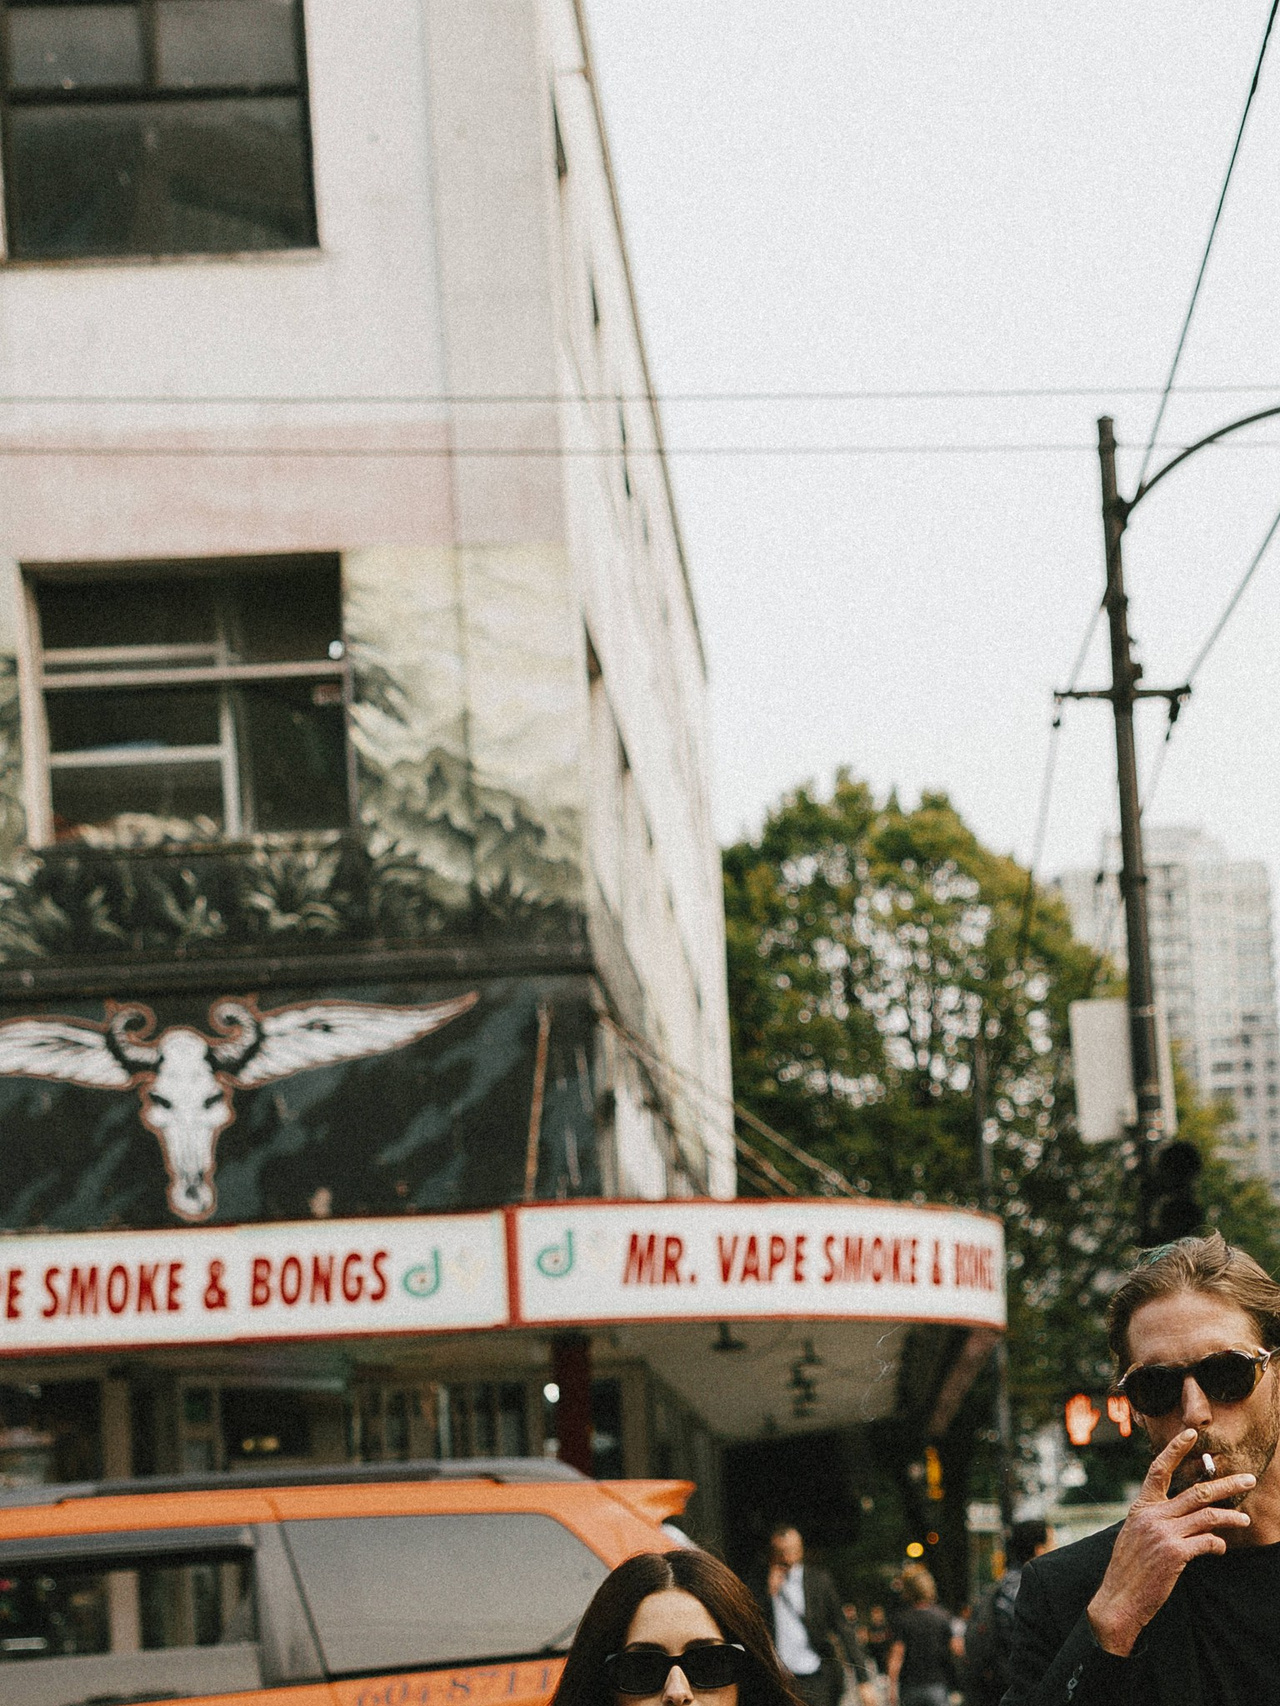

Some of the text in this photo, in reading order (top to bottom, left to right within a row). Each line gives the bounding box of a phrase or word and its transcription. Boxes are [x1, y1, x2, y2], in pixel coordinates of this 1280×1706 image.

[0, 1251, 389, 1319] E SMOKE & BONGS
[622, 1233, 697, 1284] MR.
[716, 1235, 808, 1283] VAPE
[822, 1236, 917, 1284] SMOKE
